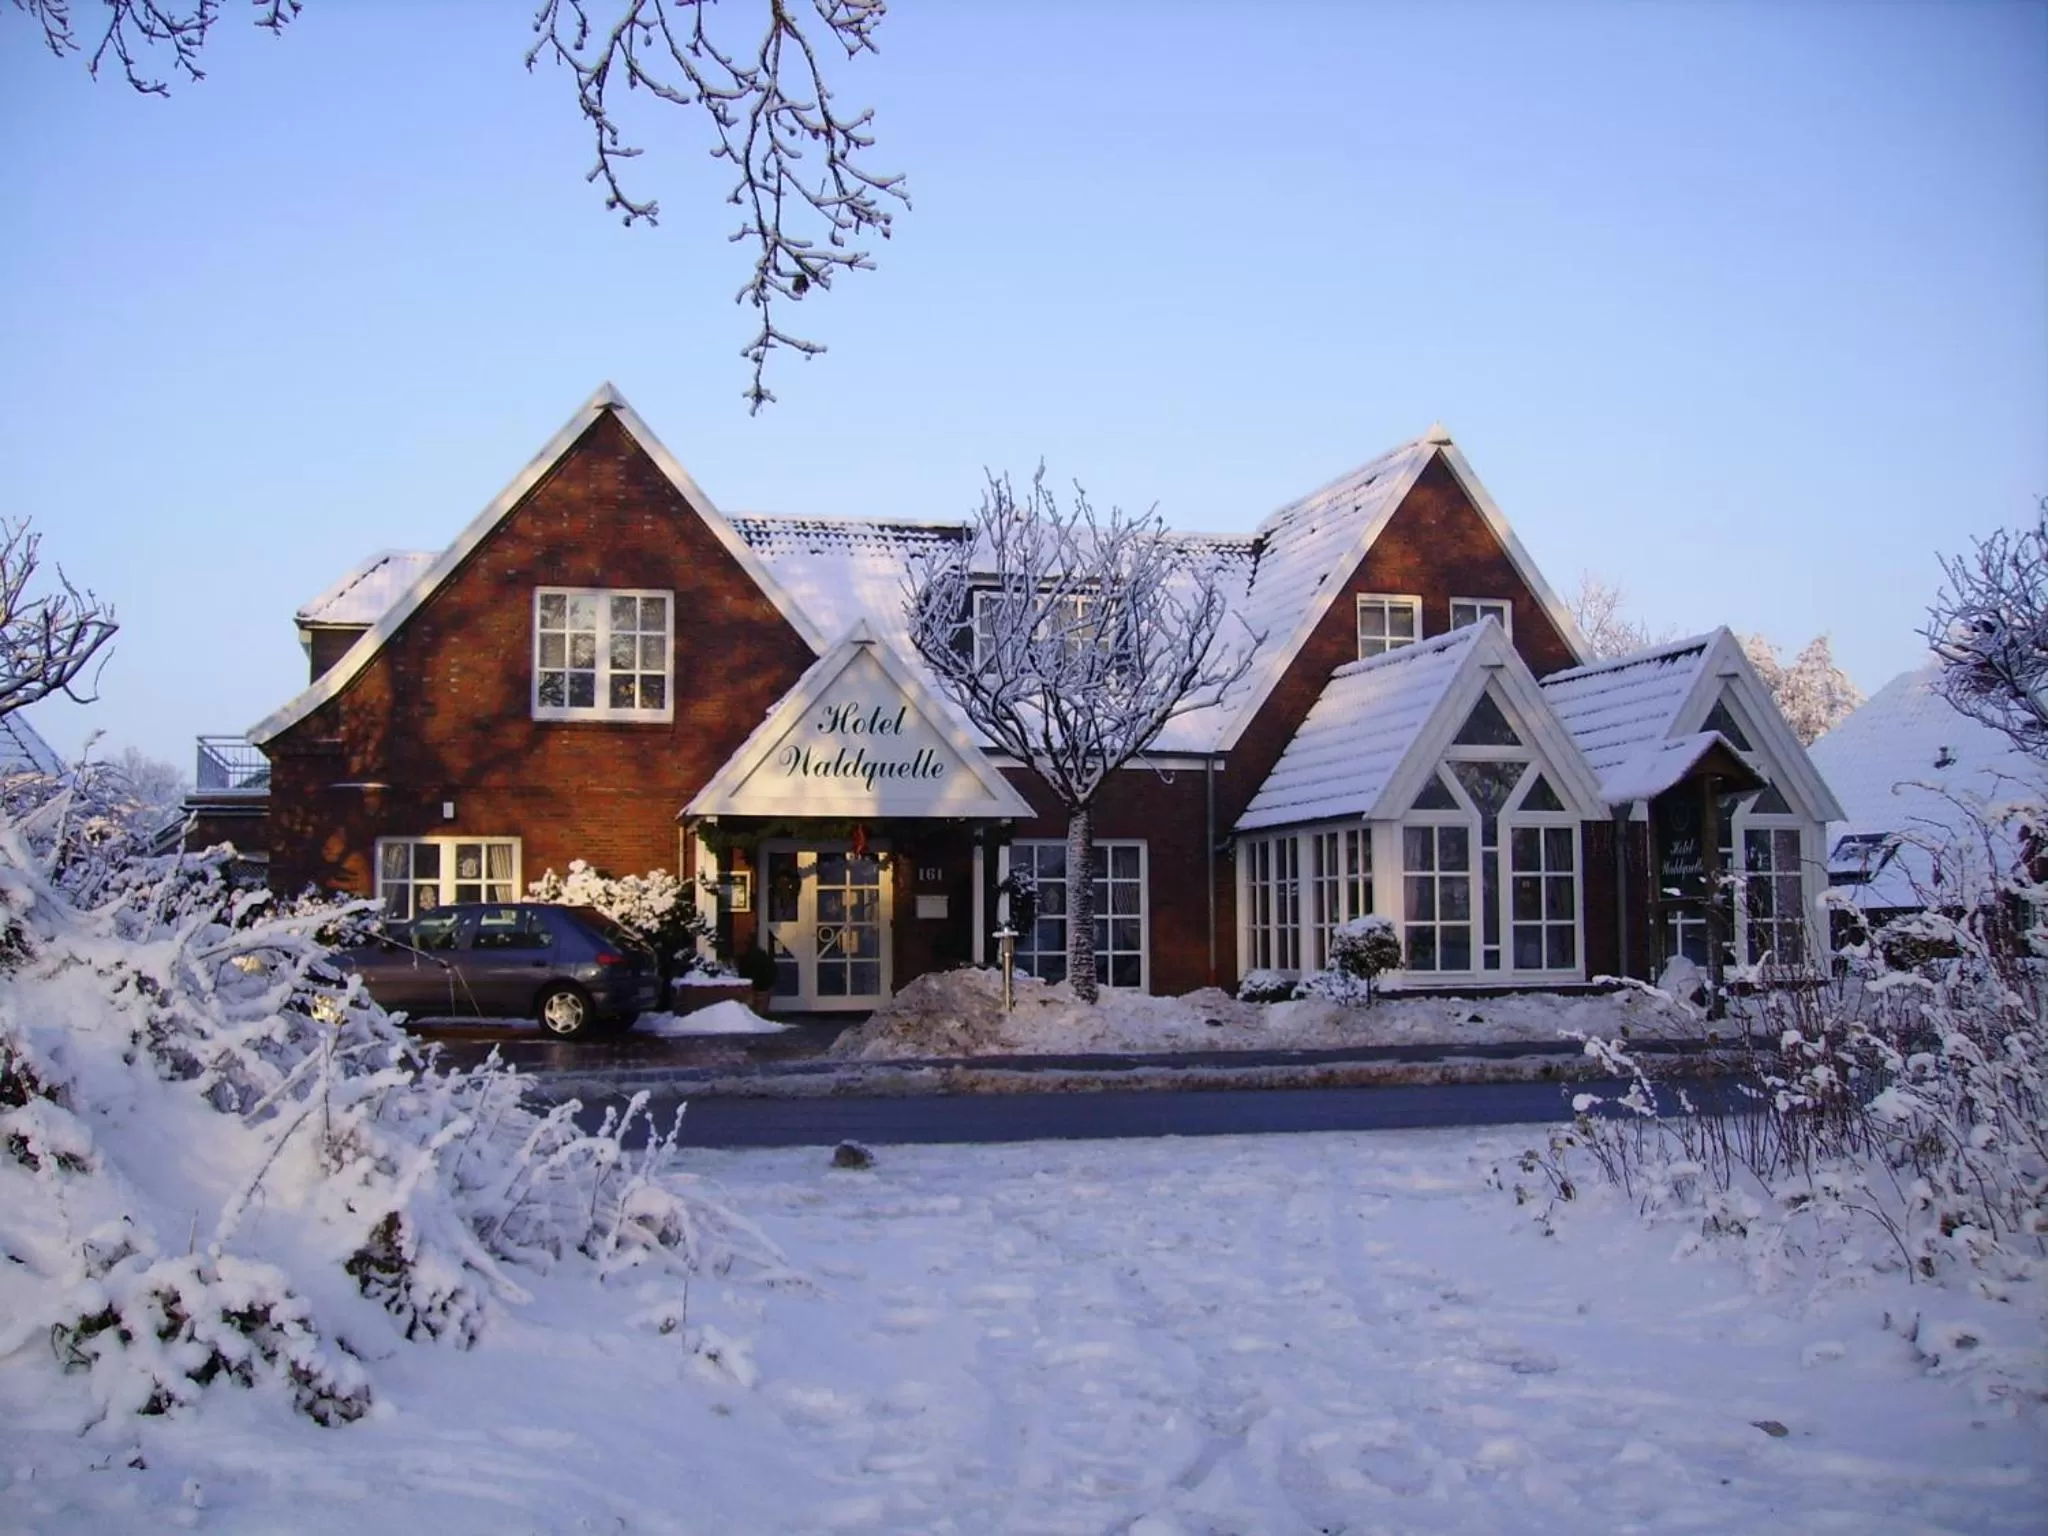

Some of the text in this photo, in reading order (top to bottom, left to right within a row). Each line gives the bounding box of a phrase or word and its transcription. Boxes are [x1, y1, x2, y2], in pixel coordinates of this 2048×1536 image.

[817, 702, 907, 735] Hotel
[779, 744, 944, 791] Waldquelle
[1669, 838, 1695, 855] Hotel
[919, 867, 943, 881] 161
